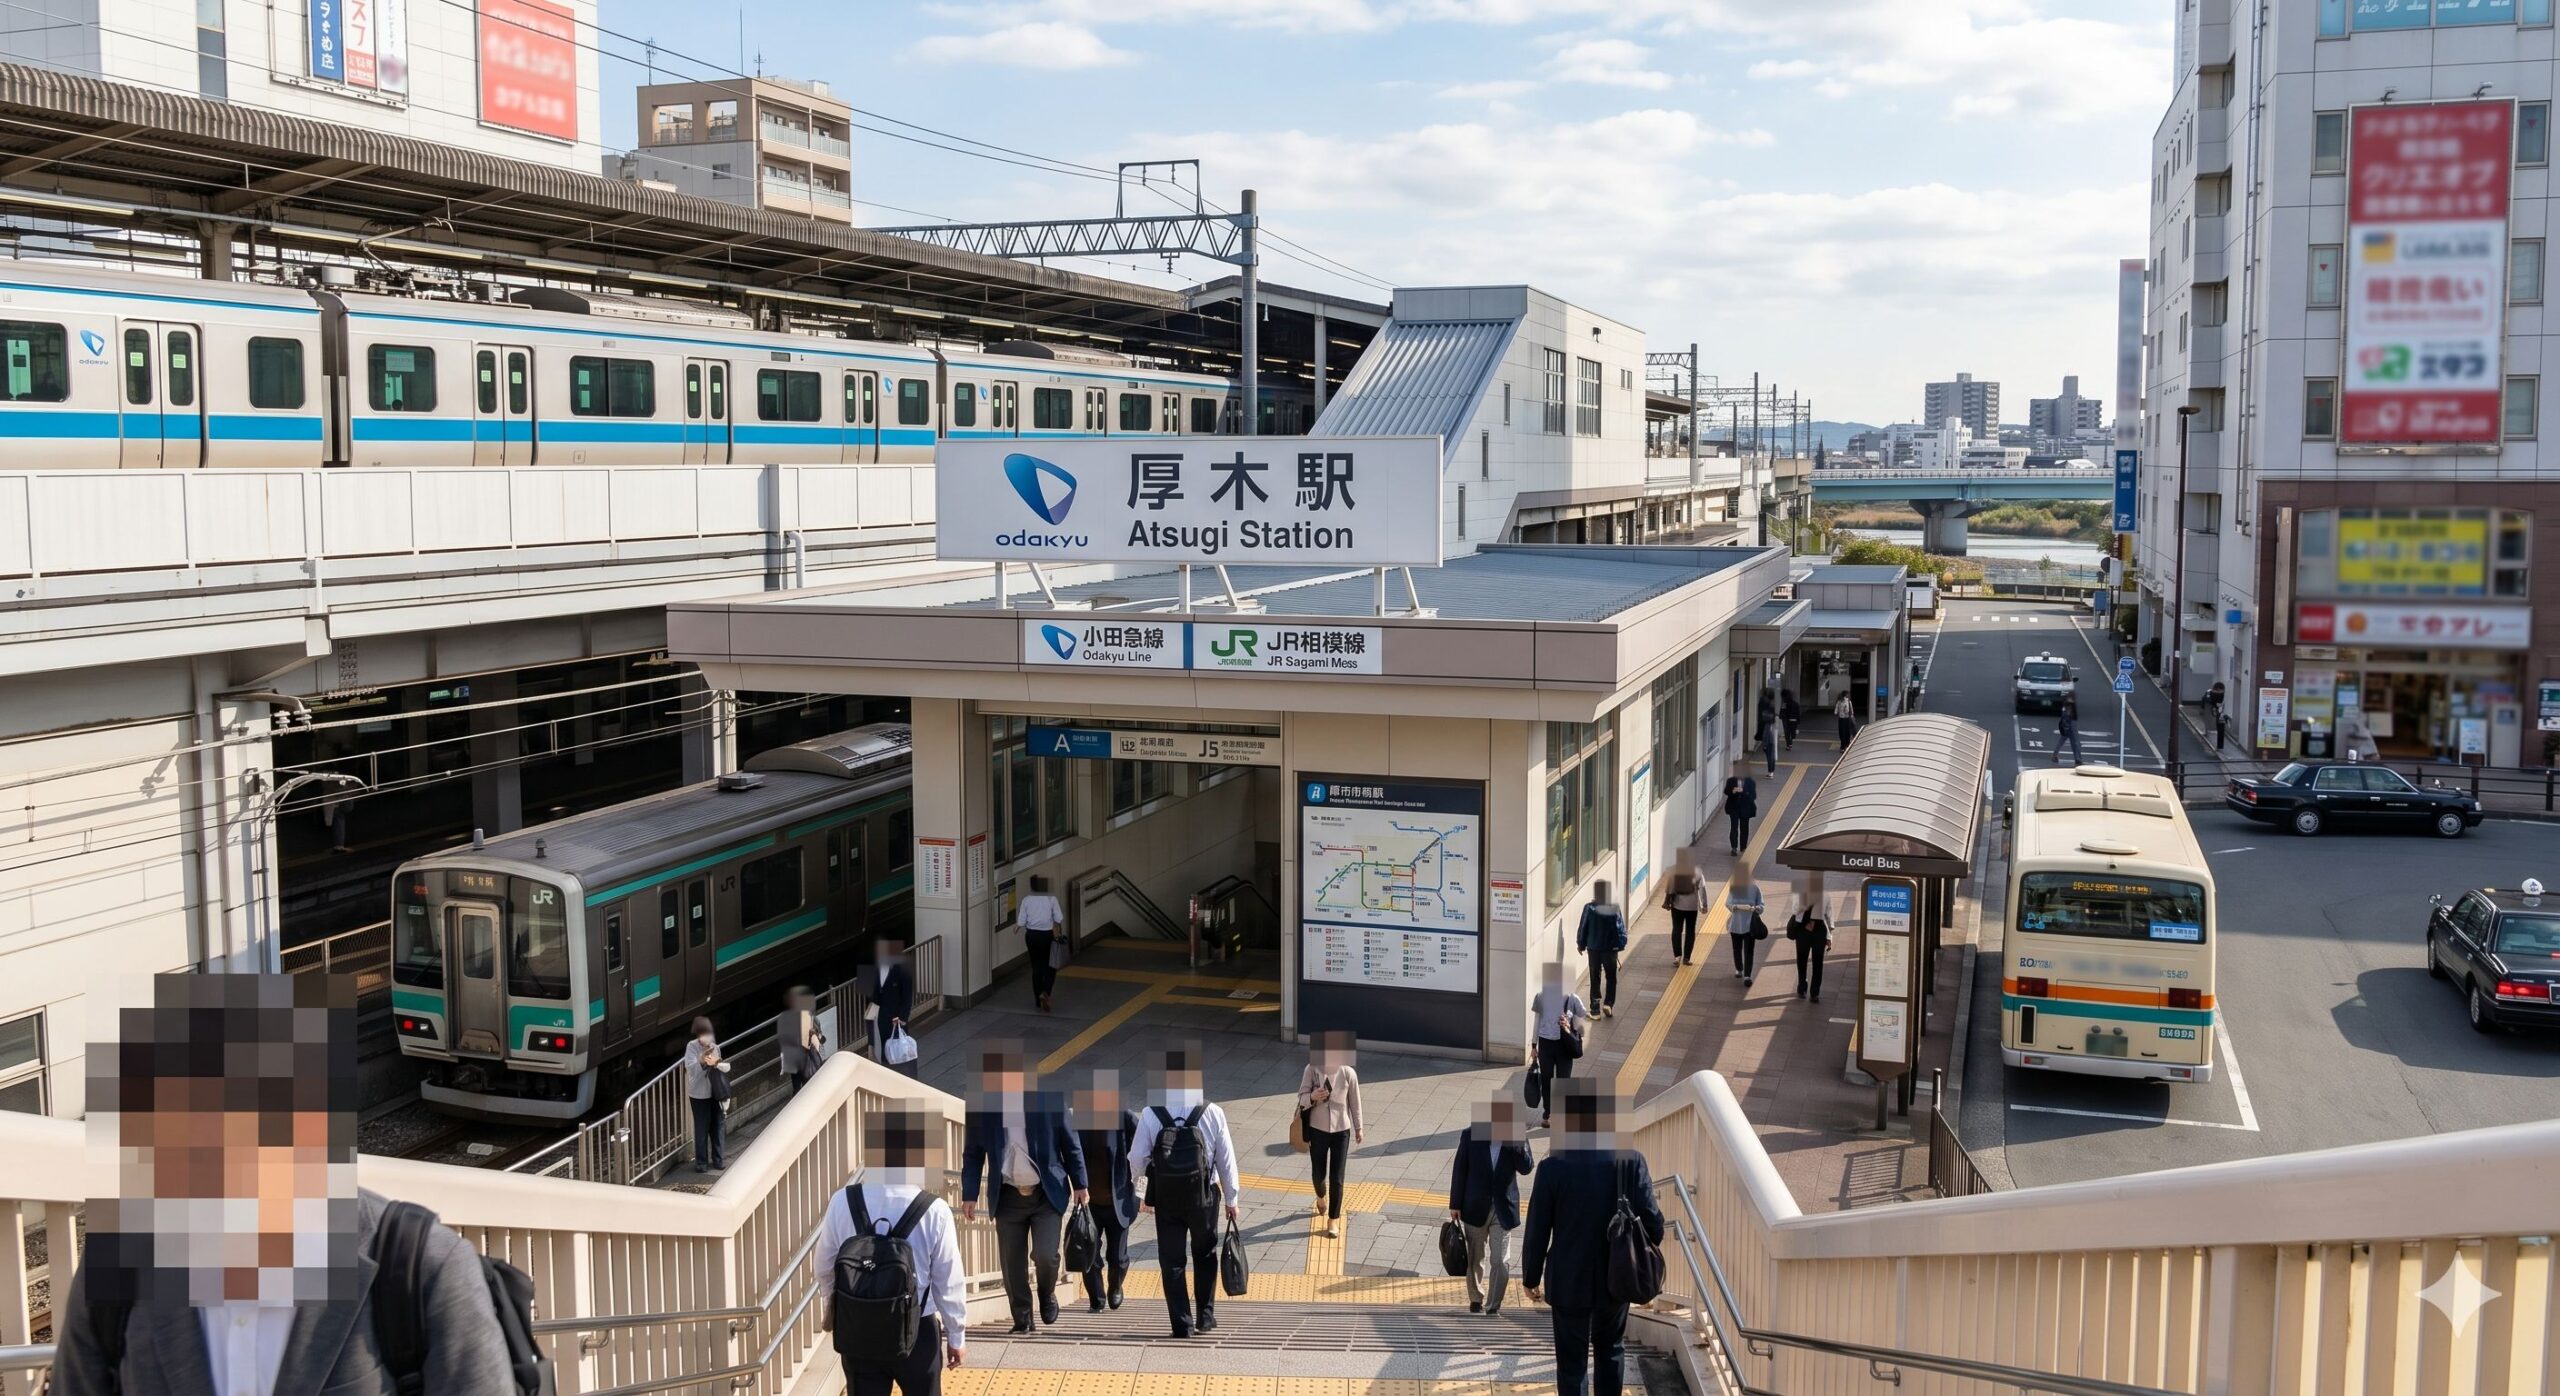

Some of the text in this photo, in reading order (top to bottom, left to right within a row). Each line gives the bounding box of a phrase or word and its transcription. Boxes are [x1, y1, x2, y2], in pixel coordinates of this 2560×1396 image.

[1127, 451, 1356, 512] 厚木駅
[995, 526, 1089, 549] odakyu
[1127, 518, 1354, 555] Atsugi Station
[1083, 625, 1164, 649] 小田急線
[1211, 629, 1259, 658] JR
[1266, 631, 1366, 655] JR相模線
[1083, 649, 1152, 664] Odakyu Line
[1267, 655, 1283, 667] JR
[1285, 656, 1329, 669] Sagami
[1331, 656, 1359, 669] Mess
[1053, 733, 1071, 753] A
[1198, 739, 1220, 758] J5
[1842, 854, 1901, 869] Local Bus
[532, 889, 554, 905] JR
